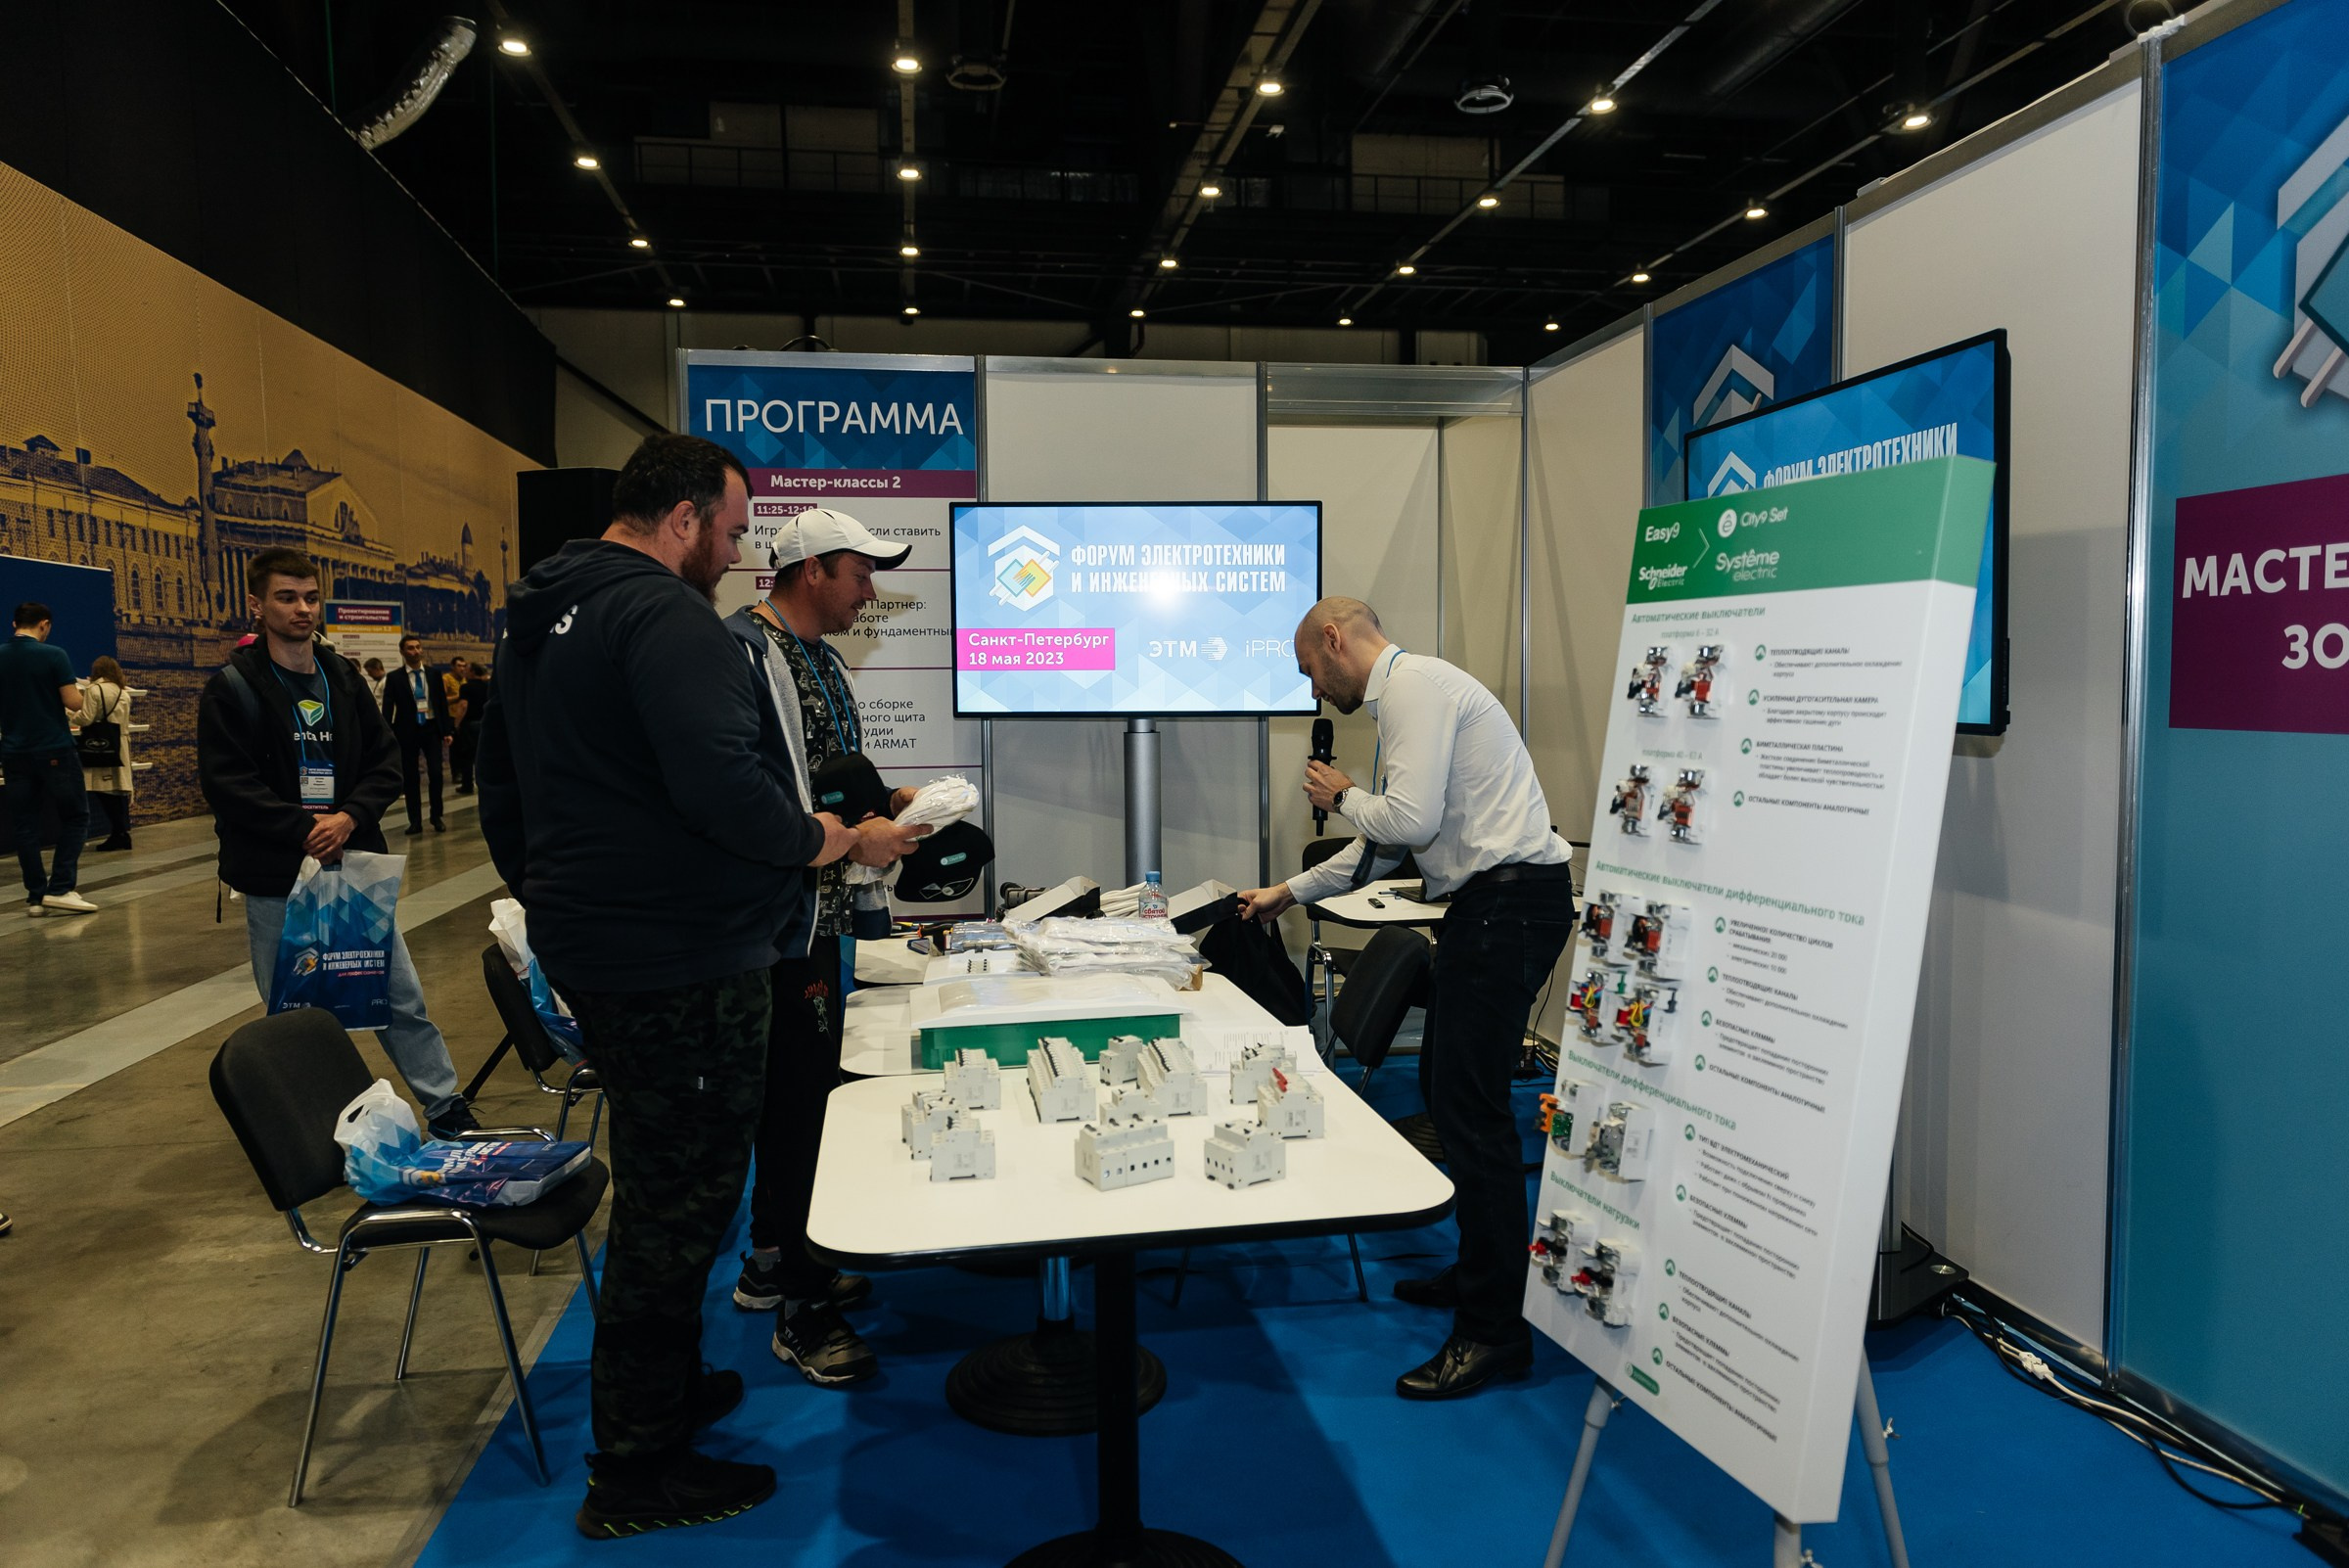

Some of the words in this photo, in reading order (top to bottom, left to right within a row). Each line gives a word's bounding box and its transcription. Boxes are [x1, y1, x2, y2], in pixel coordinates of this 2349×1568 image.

[706, 398, 964, 436] ПРОГРАММА
[1764, 459, 1814, 488] ФОРУМ
[1818, 422, 1958, 476] ЭЛЕКТРОТЕХНИКИ
[770, 475, 888, 490] Мастер-классы
[892, 476, 901, 488] 2
[1740, 511, 1768, 528] City9
[1769, 506, 1789, 523] Set
[893, 528, 941, 536] ставить
[1644, 522, 1681, 543] Easy9
[1071, 544, 1135, 567] ФОРУМ
[1141, 544, 1285, 566] ЭЛЕКТРОТЕХНИКИ
[1715, 549, 1780, 573] Systême
[1638, 563, 1688, 581] Schneider
[1732, 567, 1778, 582] electric
[2183, 542, 2349, 599] МАСТЕ
[759, 578, 776, 587] 12:
[1071, 572, 1082, 593] И
[1089, 571, 1209, 593] ИНЖЕННЫХ
[1216, 571, 1286, 593] СИСТЕМ
[1657, 576, 1685, 587] Electric
[870, 599, 927, 612] Партнер:
[550, 604, 578, 635] S
[852, 614, 889, 623] аботе
[1632, 610, 1700, 623] Автоматические
[1701, 607, 1766, 620] выключатели
[863, 626, 951, 639] фундаментны
[968, 632, 1110, 648] Санкт-Петербург
[1149, 641, 1197, 658] ЭТМ
[969, 652, 987, 666] 18
[991, 655, 1021, 666] мая
[1026, 652, 1064, 666] 2023
[857, 701, 866, 710] о
[869, 699, 914, 712] сборке
[861, 715, 891, 723] ного
[894, 714, 926, 723] щита
[294, 730, 318, 742] enta
[863, 727, 894, 738] удии
[873, 738, 917, 749] ARMAT
[1756, 741, 1811, 751] БИМЕТАЛЛИЧЕСКАЯ
[1748, 796, 1780, 806] ОСТАЛЬНЫЕ
[1781, 800, 1822, 809] КОМПОНЕНТЫ
[1822, 804, 1870, 815] АНАЛОГИЧНЫЕ
[1594, 860, 1661, 884] Автоматические
[1662, 873, 1725, 897] выключатели
[1725, 886, 1835, 921] дифференциального
[1838, 910, 1865, 926] тока
[1770, 929, 1808, 943] КОЛИЧЕСТВО
[1808, 938, 1834, 949] ЦИКЛОВ
[1773, 989, 1799, 1001] КАНАЛЫ
[1709, 1064, 1740, 1082] ОСТАЛЬНЫЕ
[1740, 1076, 1780, 1096] КОМПОНЕНТЫ
[1568, 1049, 1621, 1081] Выключатели
[1620, 1074, 1713, 1121] дифференциального
[1714, 1113, 1736, 1131] тока
[1549, 1170, 1602, 1209] Выключатели
[1602, 1202, 1640, 1230] нагрузки
